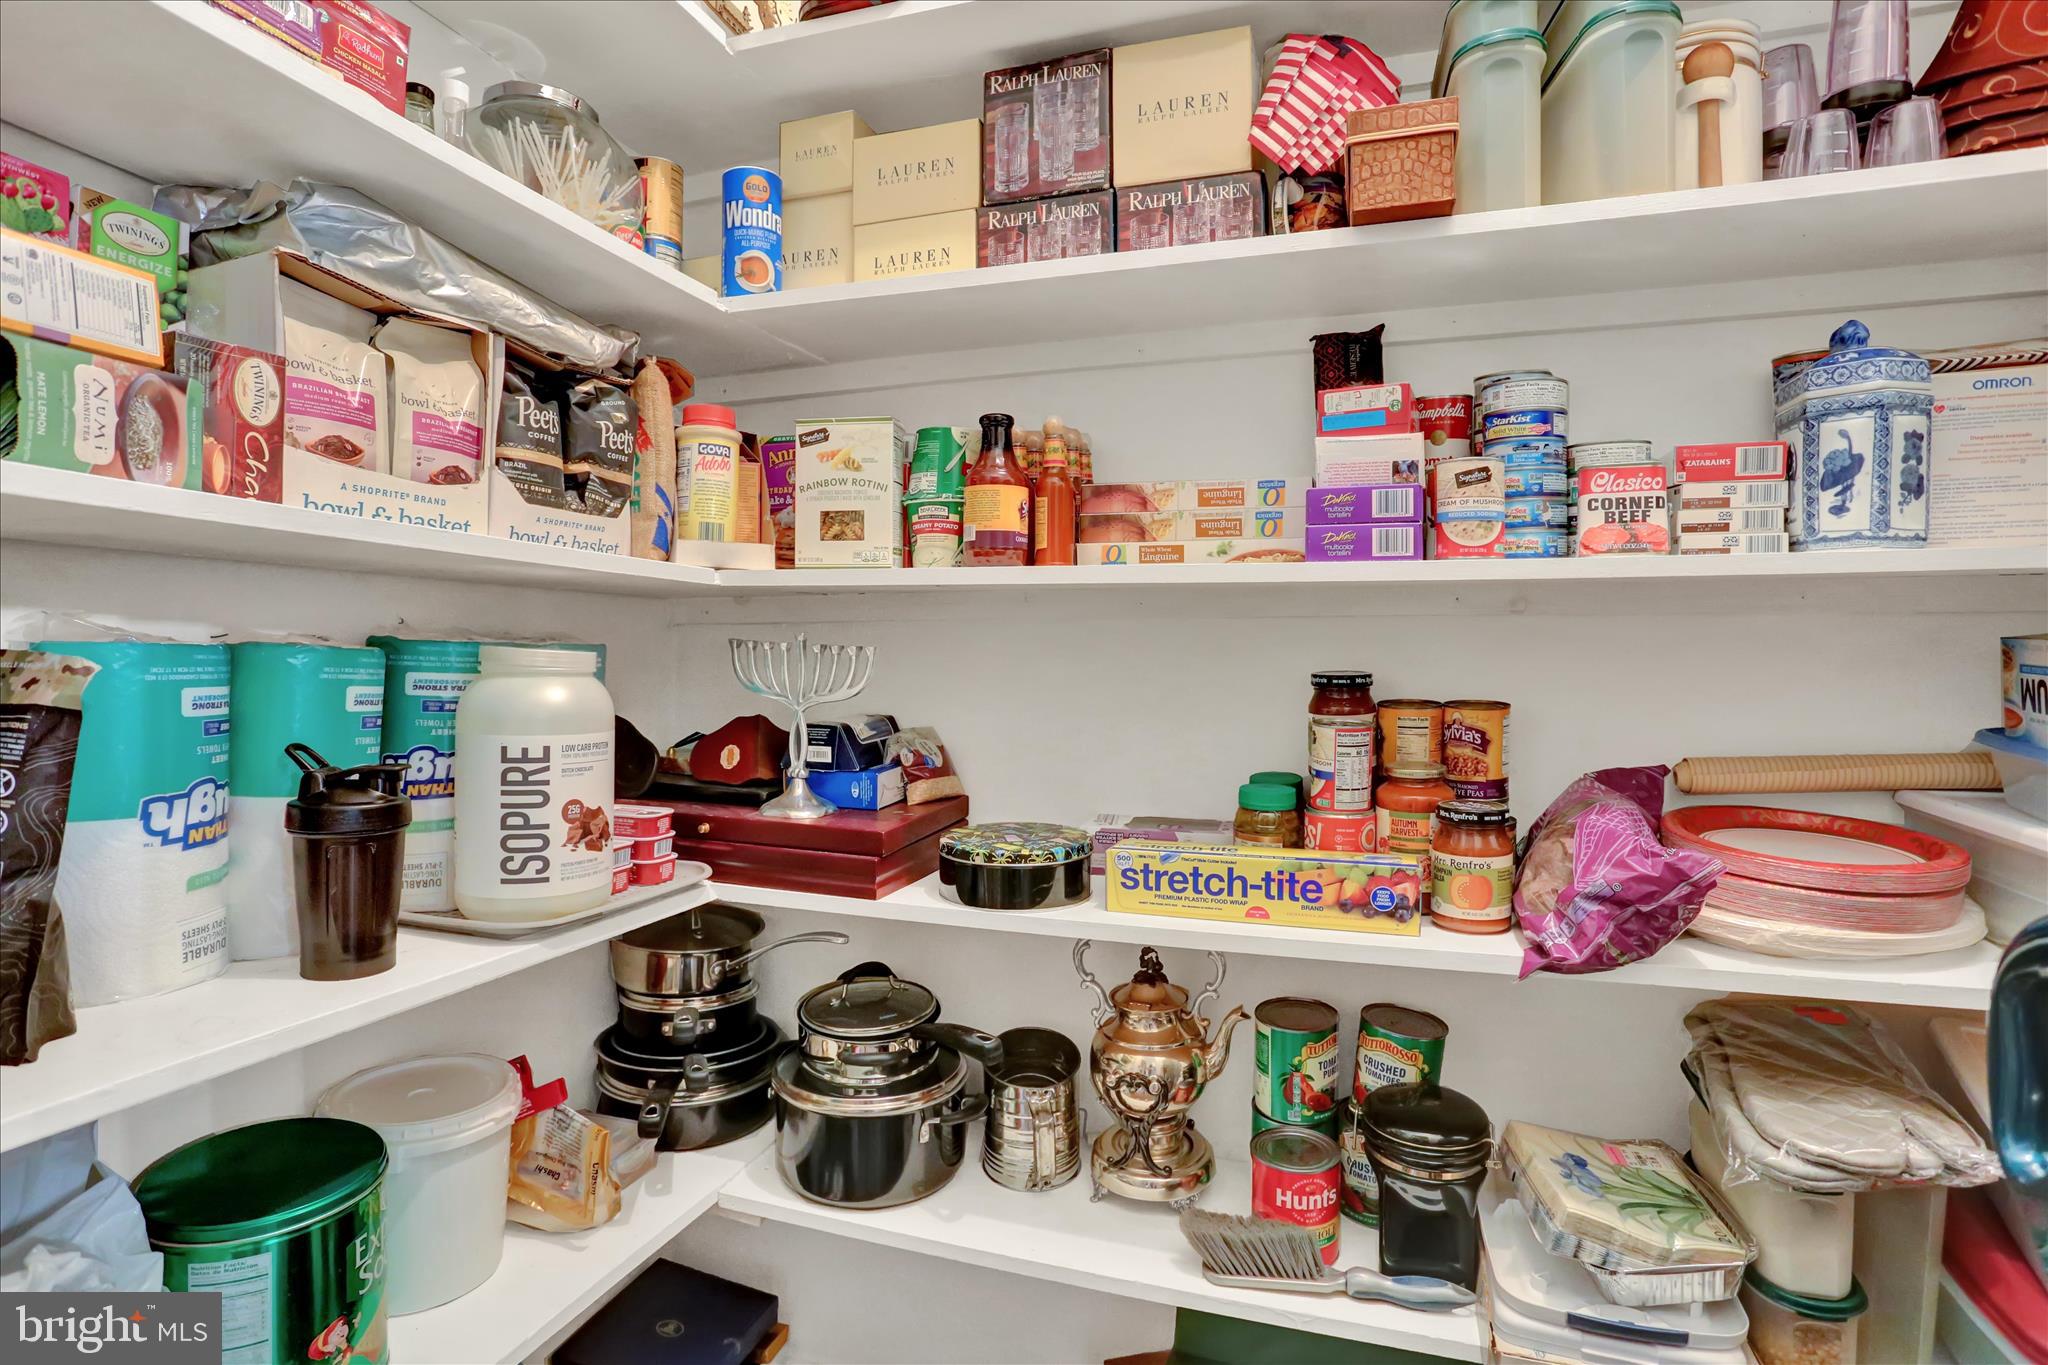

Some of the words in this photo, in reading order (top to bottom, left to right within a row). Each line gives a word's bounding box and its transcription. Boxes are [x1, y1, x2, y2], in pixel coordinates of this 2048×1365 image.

[352, 37, 383, 63] Radhuni
[333, 47, 362, 67] CHICKEN
[362, 60, 387, 81] MASALA
[990, 74, 1038, 95] RALPH
[1043, 62, 1102, 84] LAUREN
[1138, 90, 1230, 117] LAUREN
[1138, 112, 1175, 124] RALPH
[1184, 106, 1231, 117] LAUREN
[795, 145, 837, 158] LAUREN
[878, 157, 955, 180] LAUREN
[878, 176, 909, 186] RALPH
[916, 170, 955, 181] LAUREN
[745, 182, 768, 193] GOLD
[82, 195, 105, 210] NEW
[1128, 190, 1182, 212] RALPH
[1186, 182, 1250, 203] LAUREN
[726, 200, 782, 235] Wondra
[988, 211, 1036, 230] RALPH
[1040, 201, 1100, 222] LAUREN
[107, 222, 166, 249] TWININGS
[96, 244, 173, 278] ENERGIZE
[875, 246, 951, 270] LAUREN
[874, 265, 904, 276] RALPH
[912, 259, 951, 271] LAUREN
[1349, 344, 1357, 378] RESERVE
[36, 371, 45, 401] MATE
[331, 370, 373, 389] basket
[1972, 376, 2033, 391] OMRON
[249, 362, 263, 422] TWININGS
[292, 382, 333, 397] BRAZILIAN
[83, 383, 91, 422] ORGANIC
[401, 392, 429, 409] bowl
[36, 402, 45, 436] LEMON
[515, 396, 559, 435] Peet's
[1492, 414, 1531, 427] StarKist
[83, 424, 91, 442] TEA
[528, 431, 556, 443] COFFEE
[595, 421, 634, 454] Peet's
[1491, 427, 1506, 435] Solid
[1507, 426, 1527, 434] White
[607, 452, 629, 463] COFFEE
[699, 443, 731, 457] GOYA
[769, 448, 795, 468] Ann
[244, 432, 269, 500] Cha
[504, 461, 528, 470] BRAZIL
[695, 454, 732, 474] Adobo
[799, 477, 849, 494] RAINBOW
[851, 478, 889, 494] ROTINI
[1258, 480, 1285, 488] organics
[1590, 471, 1663, 491] Clasico
[340, 482, 348, 491] A
[414, 494, 447, 506] BRAND
[531, 486, 552, 494] ORIGIN
[1203, 490, 1243, 500] Linguine
[1263, 487, 1281, 507] O
[1321, 491, 1357, 506] DaVinci
[1473, 499, 1504, 507] MUSHROO
[1587, 495, 1666, 512] CORNED
[1255, 511, 1283, 519] organics
[1325, 505, 1354, 513] multicolor
[1604, 509, 1652, 524] BEEF
[584, 524, 606, 533] BRAND
[913, 523, 934, 531] CREAMY
[934, 522, 959, 530] POTATO
[1200, 521, 1241, 531] Linguine
[1260, 518, 1278, 538] O
[1321, 530, 1357, 545] DaVinci
[1141, 552, 1179, 563] Linguine
[412, 684, 449, 692] STRONG
[192, 701, 224, 711] STRONG
[415, 719, 444, 727] TOWELS
[196, 743, 221, 754] TOWELS
[561, 744, 575, 752] LOW
[576, 743, 591, 752] CARB
[592, 742, 609, 751] PROTEIN
[1467, 788, 1485, 798] PEAS
[500, 745, 550, 884] ISOPURE
[567, 804, 581, 815] 25G
[1439, 809, 1450, 818] Mrs.
[1450, 810, 1478, 822] Renfro's
[1391, 818, 1418, 829] AUTUMN
[1391, 827, 1419, 838] HARVEST
[425, 862, 443, 870] 2-PLY
[1116, 854, 1131, 863] 500
[1433, 855, 1448, 868] Mrs.
[1450, 856, 1492, 870] Renfro's
[404, 870, 443, 878] LONG-LASTIN
[1433, 865, 1453, 877] PUMPKIN
[1120, 862, 1324, 904] stretch-tite
[1154, 893, 1183, 902] PREMIUM
[1184, 895, 1209, 904] PLASTIC
[1211, 897, 1228, 905] FOOD
[1229, 898, 1249, 906] WRAP
[1300, 904, 1324, 912] BRAND
[182, 922, 209, 940] SHEETS
[182, 937, 226, 964] DURABLE
[1360, 1032, 1418, 1063] TUTTOROSSO
[1318, 1055, 1337, 1072] TOMA
[1363, 1054, 1406, 1079] CRUSHED
[535, 1163, 561, 1181] Chashi
[1276, 1186, 1338, 1211] Hunt's
